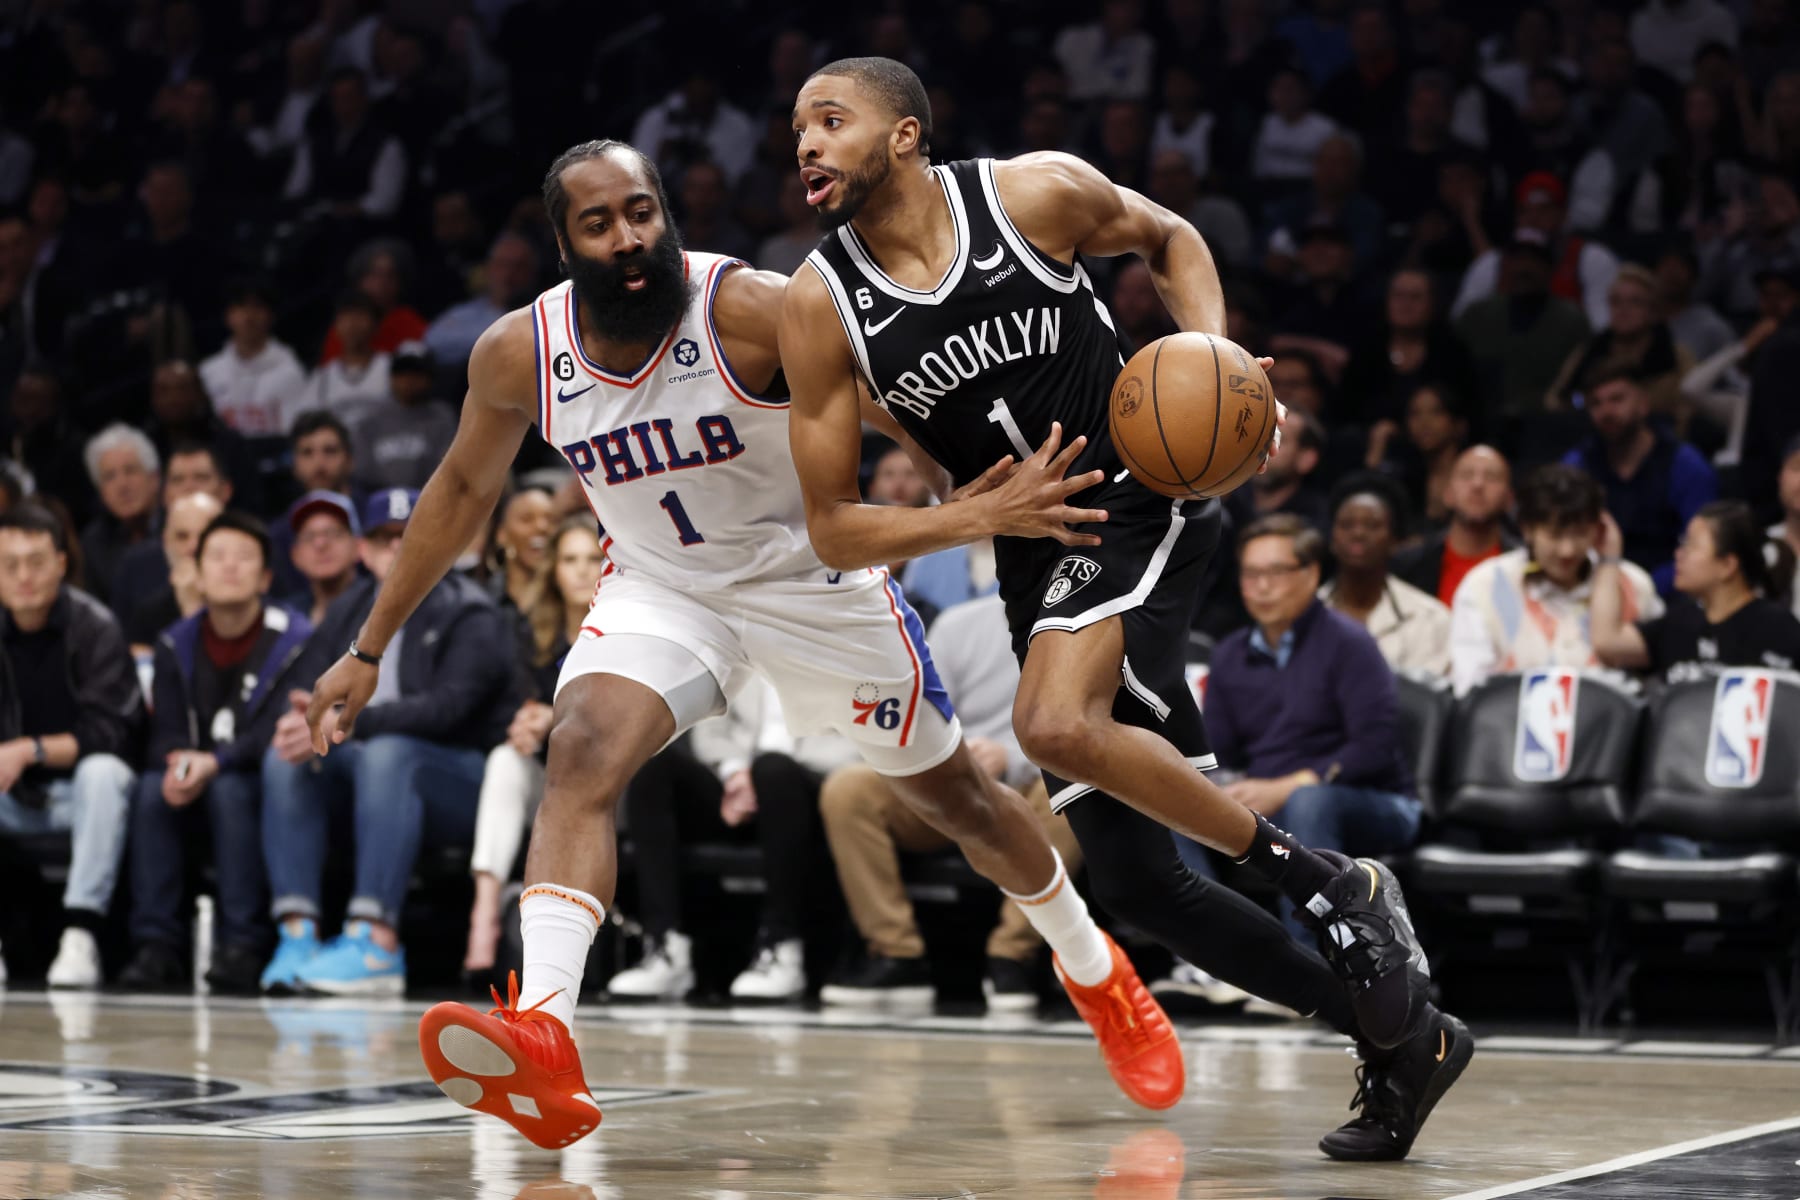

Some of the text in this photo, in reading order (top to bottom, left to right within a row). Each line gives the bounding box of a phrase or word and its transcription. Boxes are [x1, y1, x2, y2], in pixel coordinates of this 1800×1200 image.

[985, 263, 1016, 287] Webull
[855, 288, 873, 309] 6
[559, 355, 572, 378] 6
[668, 367, 715, 384] crypto.com
[886, 307, 1061, 420] BROOKLYN
[987, 398, 1034, 461] 1
[563, 414, 744, 487] PHILA
[660, 491, 705, 545] 1
[852, 698, 900, 730] 76
